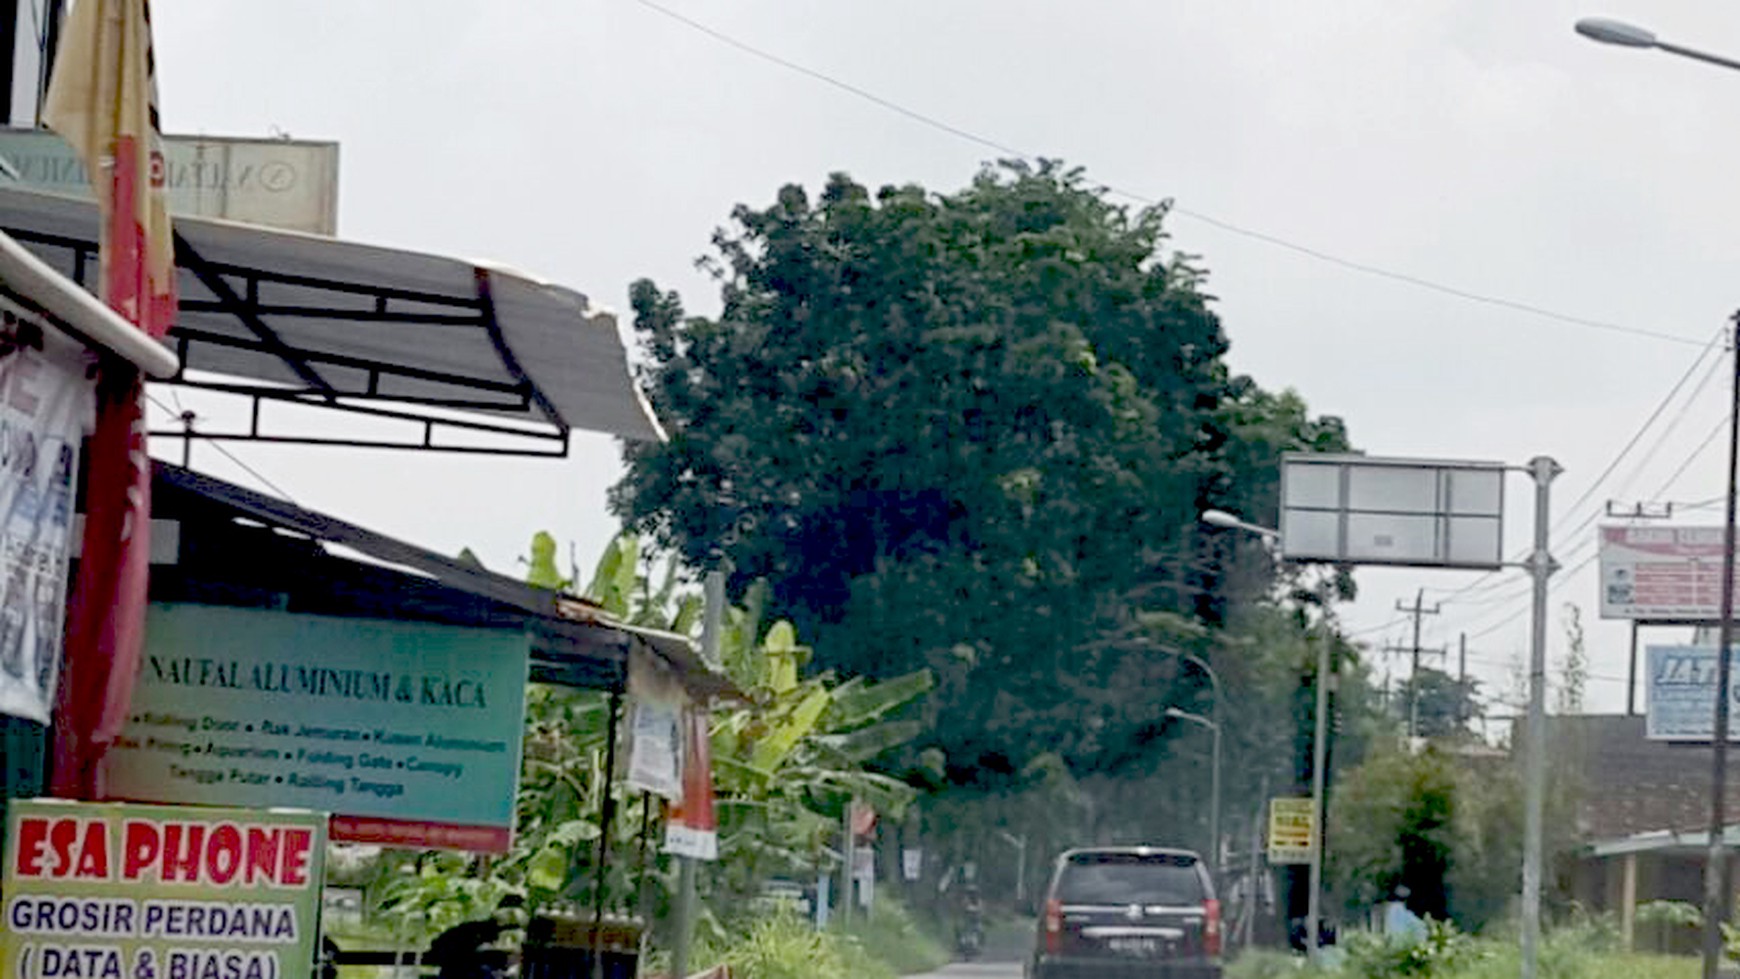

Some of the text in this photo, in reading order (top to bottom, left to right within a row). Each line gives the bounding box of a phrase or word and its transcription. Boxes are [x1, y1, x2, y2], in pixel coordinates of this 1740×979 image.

[148, 656, 487, 708] NAUFAL ALUMINIUM & KACA
[16, 819, 312, 886] ESA PHONE
[13, 900, 295, 938] GROSIR PERDANA
